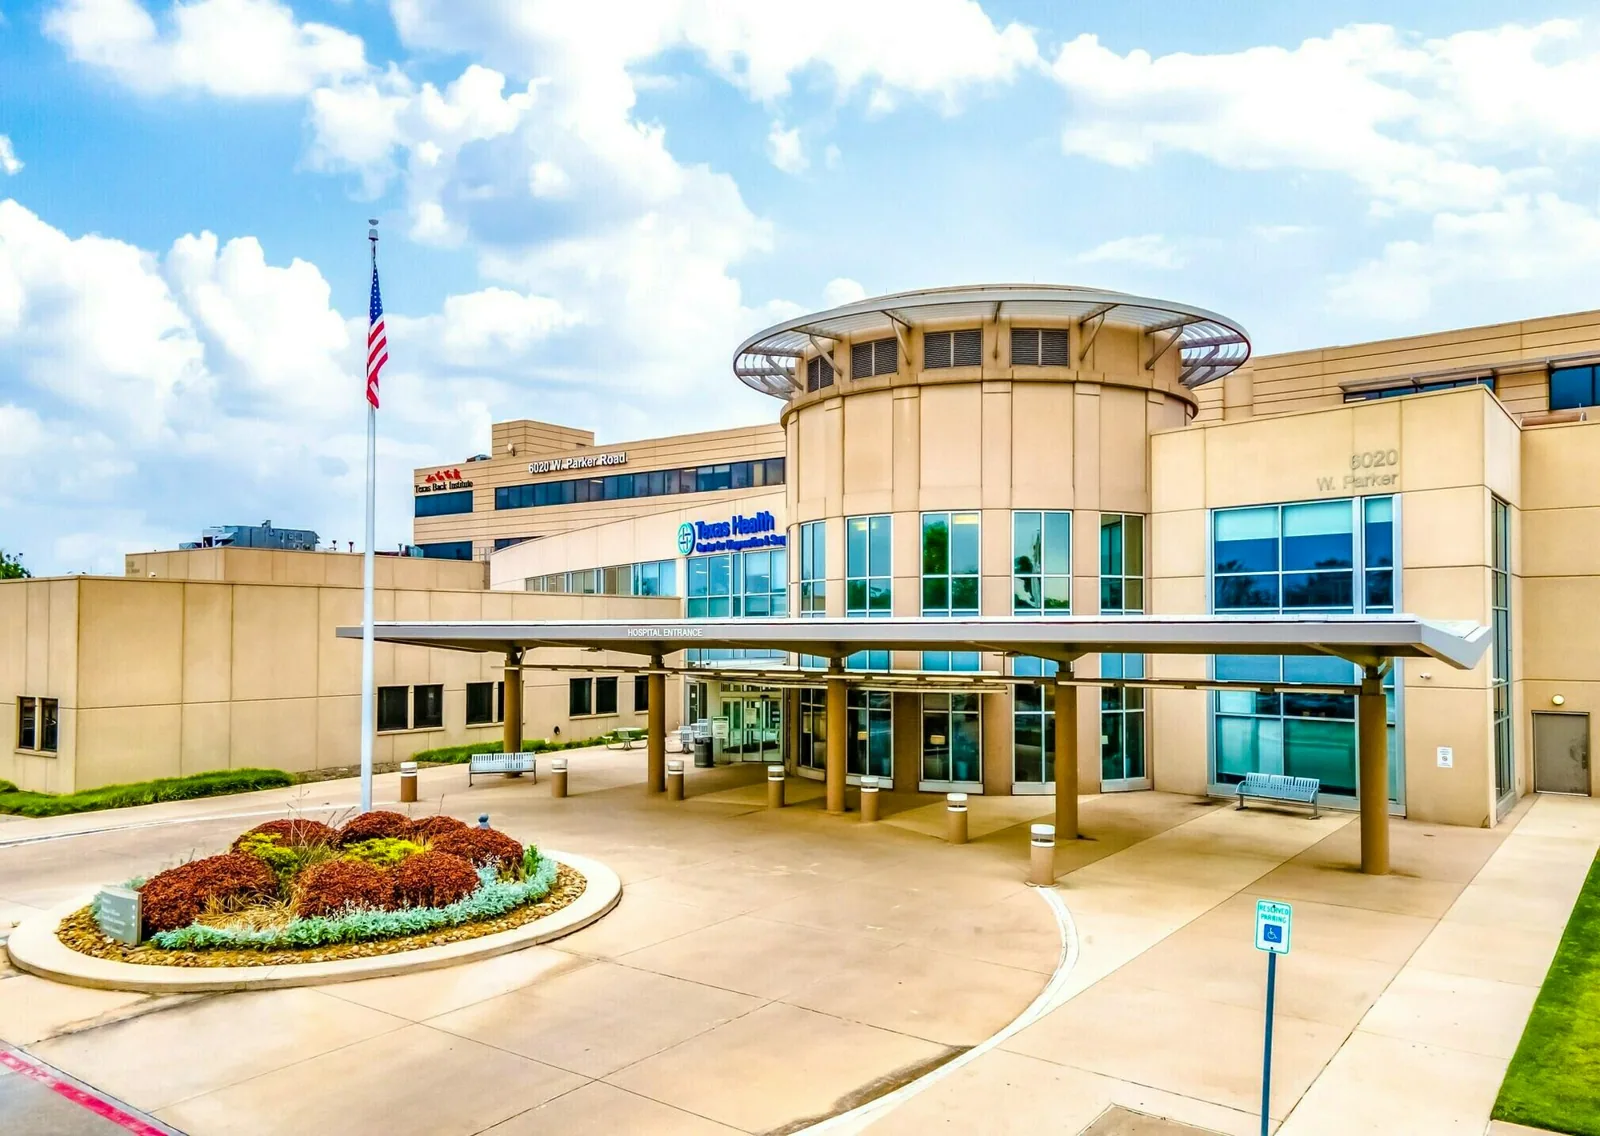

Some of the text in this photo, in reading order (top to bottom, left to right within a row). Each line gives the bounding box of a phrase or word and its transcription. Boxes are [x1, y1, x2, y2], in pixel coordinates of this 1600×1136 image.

[528, 451, 628, 474] 6020 W. Parker Road
[1350, 448, 1399, 470] 6020
[414, 479, 473, 494] Texas Back Institute
[1316, 473, 1399, 491] W. Parker
[695, 510, 775, 540] Texas Health
[627, 628, 703, 637] HOSPITAL ENTRANCE
[1258, 904, 1289, 924] RESERVED PARKING
